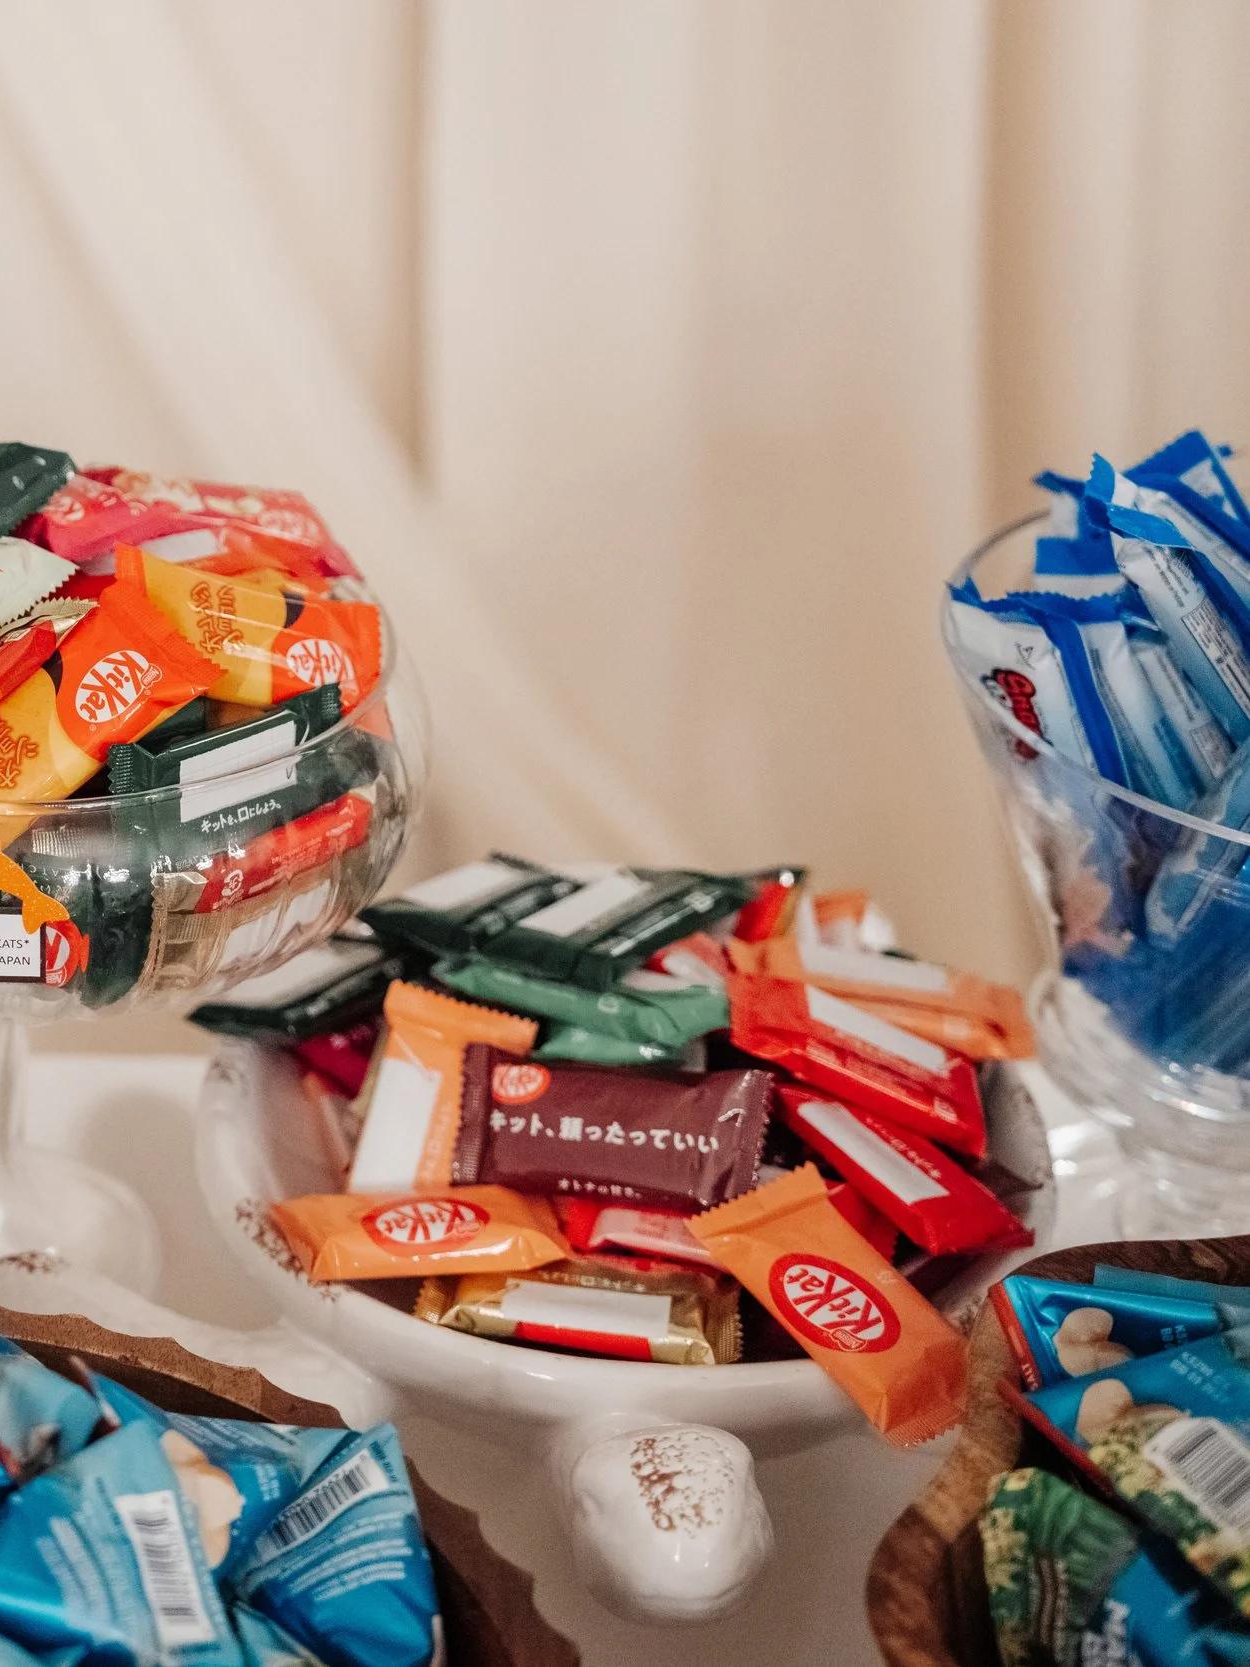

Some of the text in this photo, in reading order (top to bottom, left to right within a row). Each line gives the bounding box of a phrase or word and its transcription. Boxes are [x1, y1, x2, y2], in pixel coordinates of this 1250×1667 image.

[78, 650, 146, 722] KitKat
[202, 799, 282, 834] キットを、口にしよう。
[383, 1200, 468, 1242] KitKat
[785, 1267, 884, 1344] KitKat
